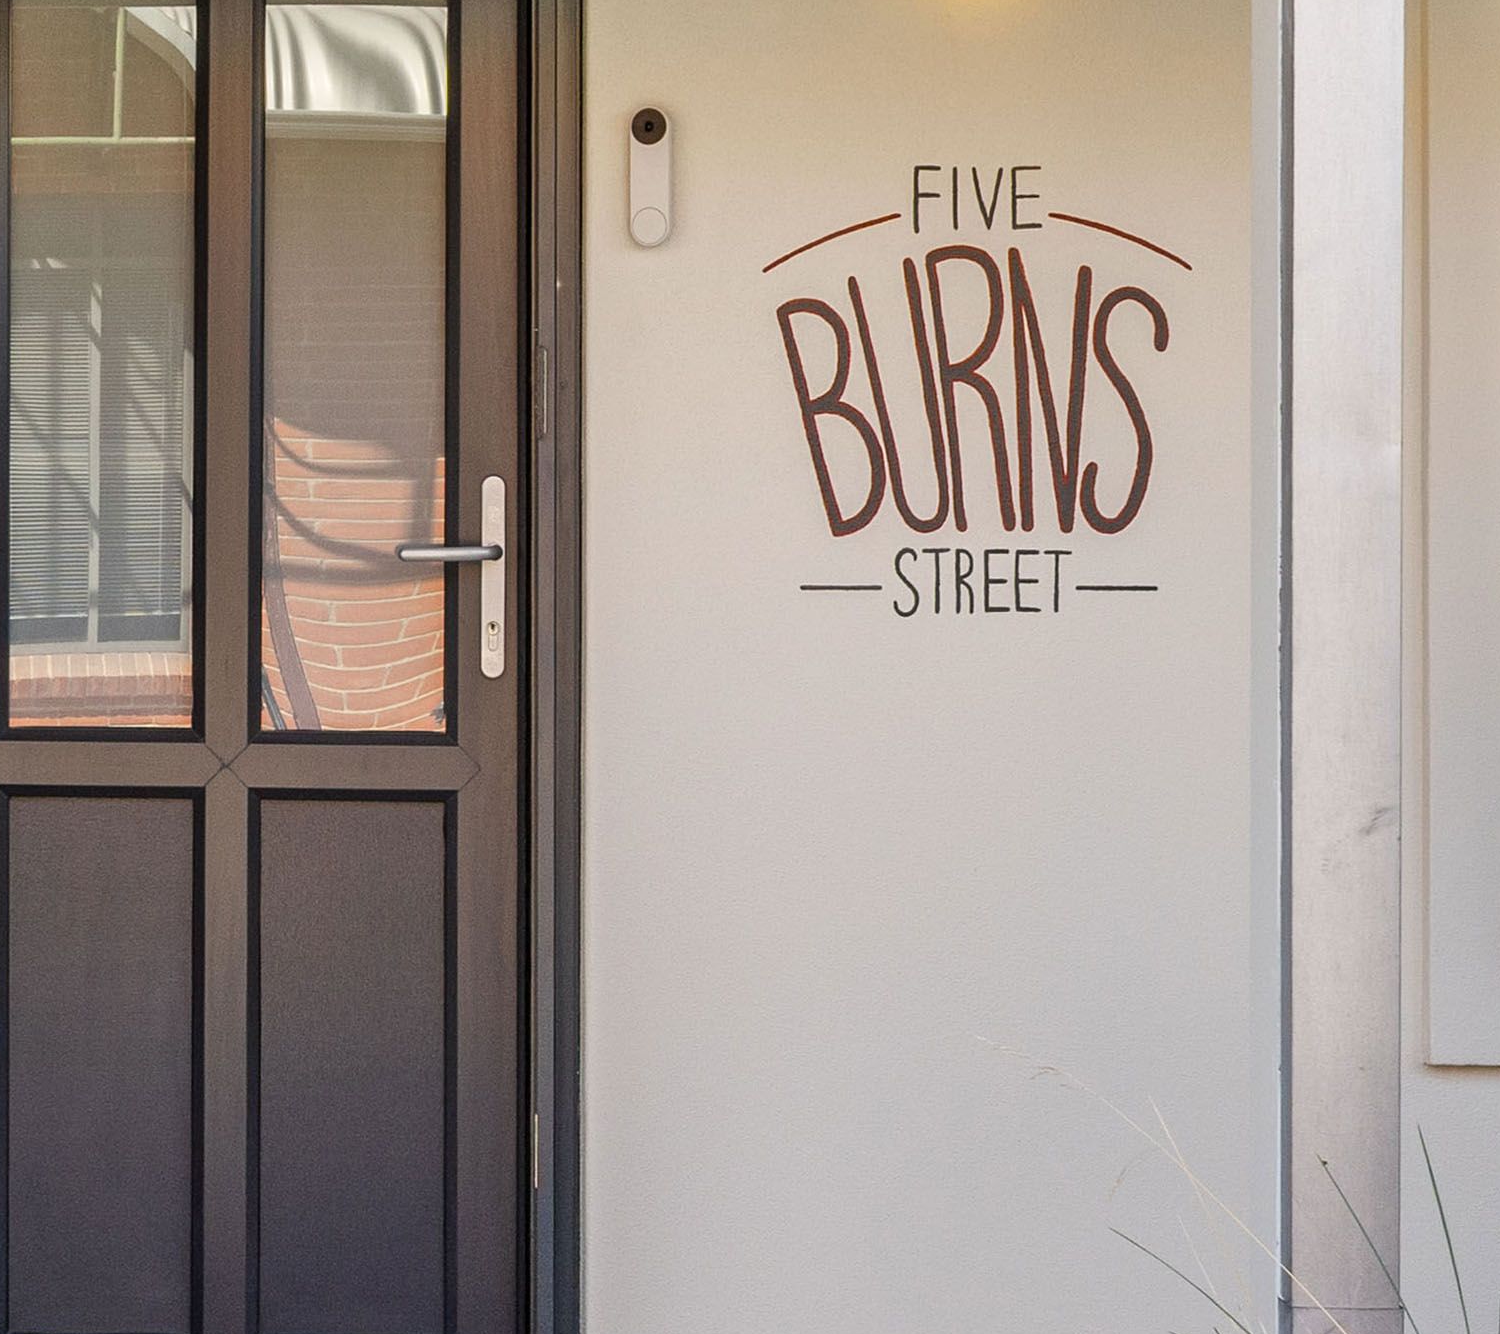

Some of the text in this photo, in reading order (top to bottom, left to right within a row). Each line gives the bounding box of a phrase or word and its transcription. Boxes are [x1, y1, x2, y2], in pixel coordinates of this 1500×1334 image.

[912, 164, 1043, 234] FIVE
[775, 244, 1170, 537] BURNS
[892, 546, 1073, 618] STREET
